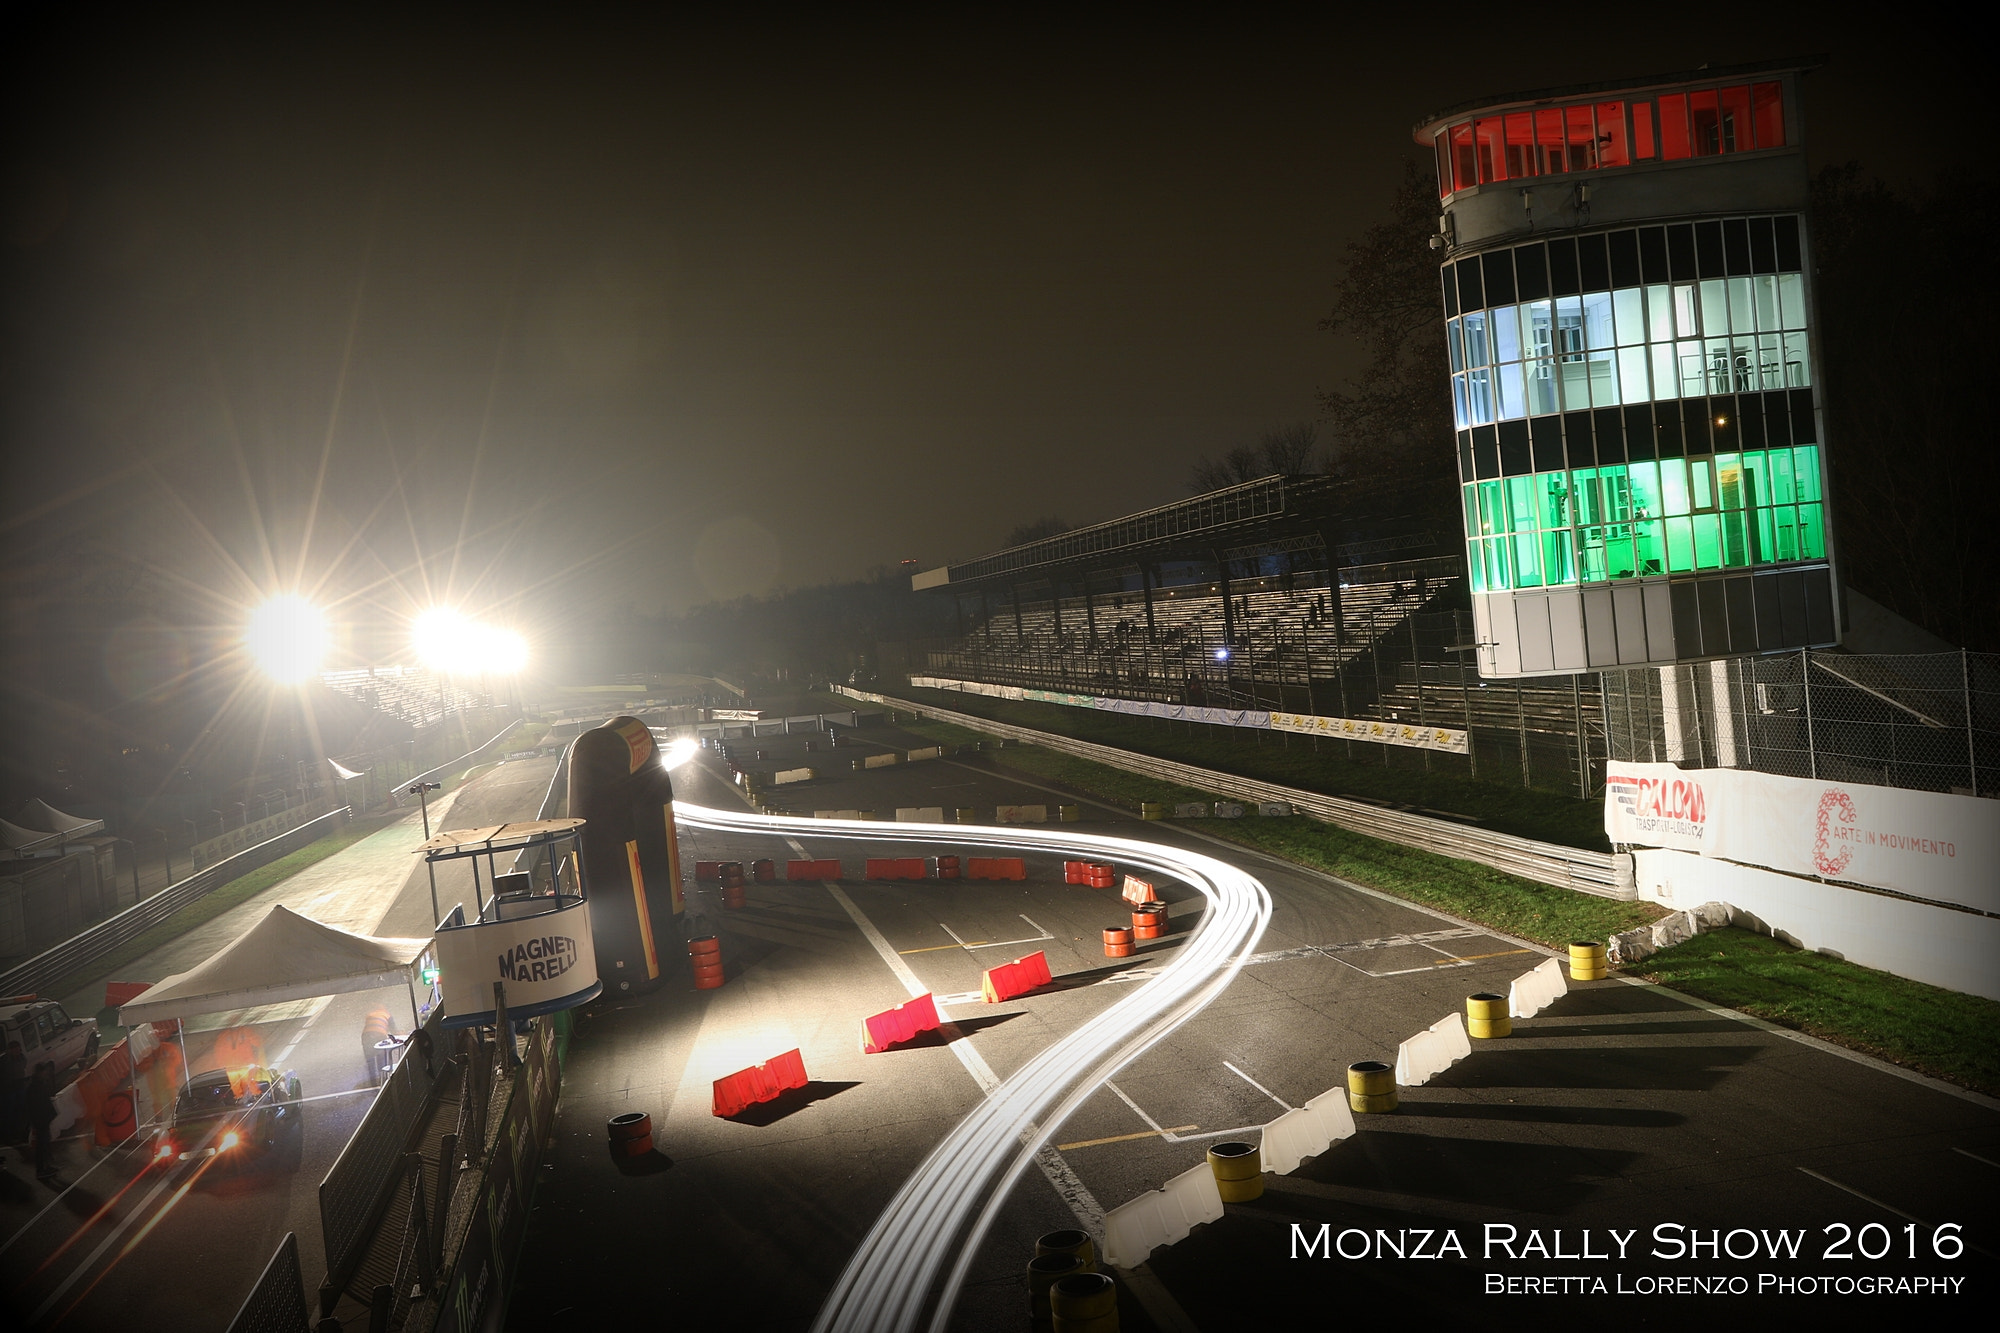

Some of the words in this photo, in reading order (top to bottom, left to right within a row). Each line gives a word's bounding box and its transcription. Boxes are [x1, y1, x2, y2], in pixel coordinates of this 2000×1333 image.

[1636, 778, 1706, 823] CALONI
[1834, 826, 1862, 843] ARTE
[1865, 831, 1876, 845] IN
[1879, 833, 1956, 858] MOVIMENTO
[499, 936, 577, 970] MAGNETI
[499, 946, 577, 982] MARELLI
